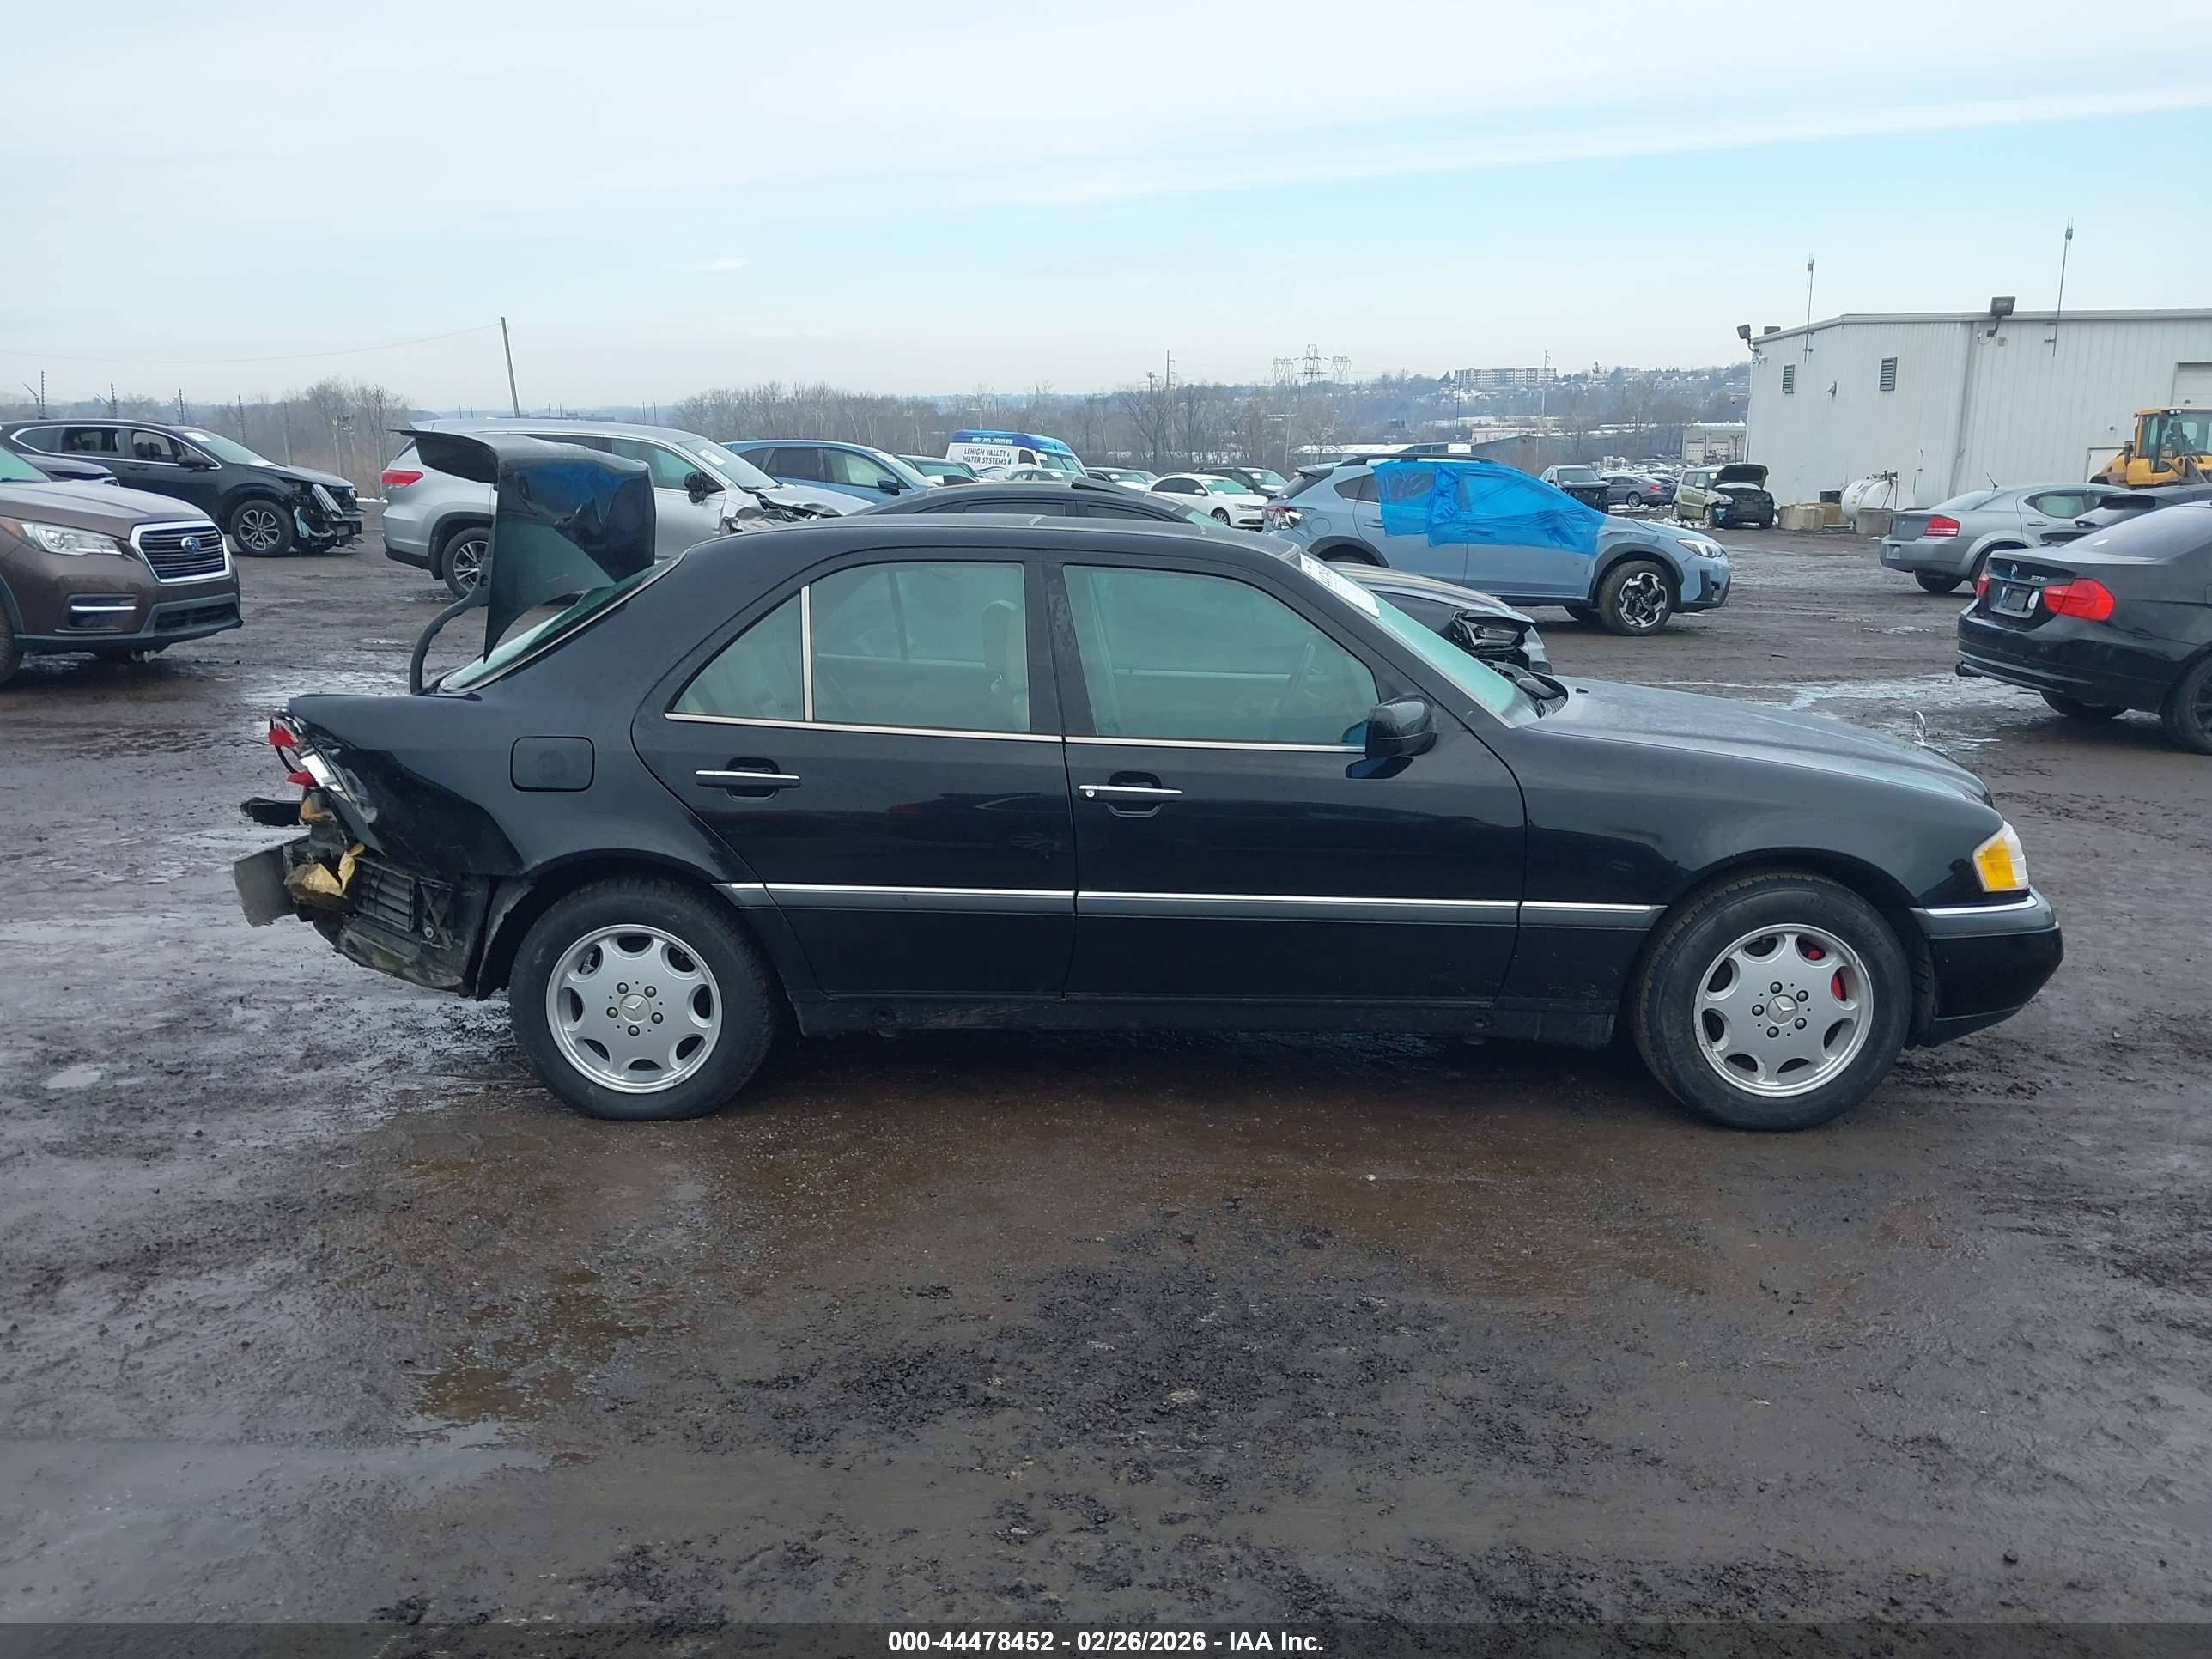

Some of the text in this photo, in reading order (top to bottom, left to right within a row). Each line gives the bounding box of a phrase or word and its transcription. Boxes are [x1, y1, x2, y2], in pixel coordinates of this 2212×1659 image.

[987, 448, 1006, 457] VALLEY
[963, 455, 1006, 465] WATER SYSTEMS
